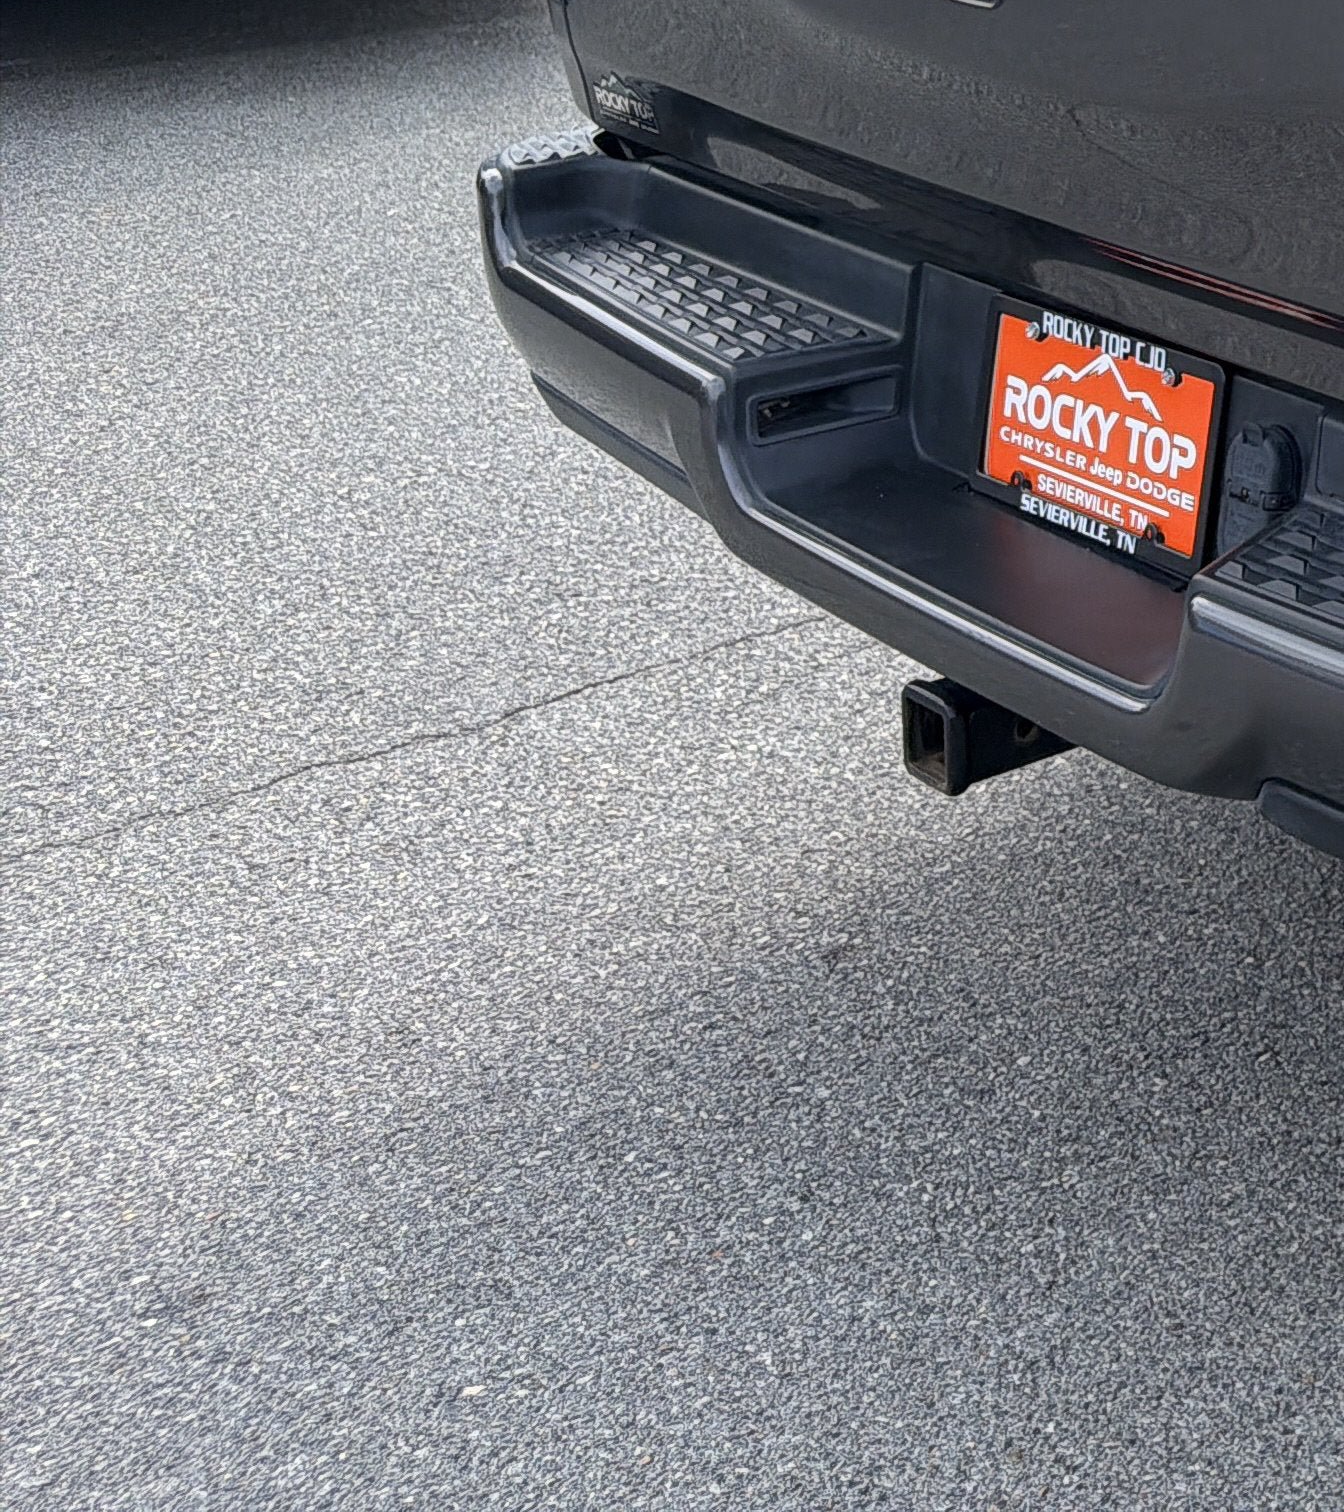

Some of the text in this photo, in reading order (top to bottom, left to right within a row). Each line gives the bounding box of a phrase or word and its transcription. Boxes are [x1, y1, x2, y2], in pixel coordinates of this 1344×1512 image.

[1042, 311, 1167, 371] ROCKY TOP CJD
[1003, 374, 1197, 479] ROCKY TOP
[1000, 425, 1196, 512] CHRYSLER Jeep DODGE
[1020, 493, 1137, 555] SEVIERVILLE, TN
[1037, 473, 1149, 532] SEVIERVILLE, TN
